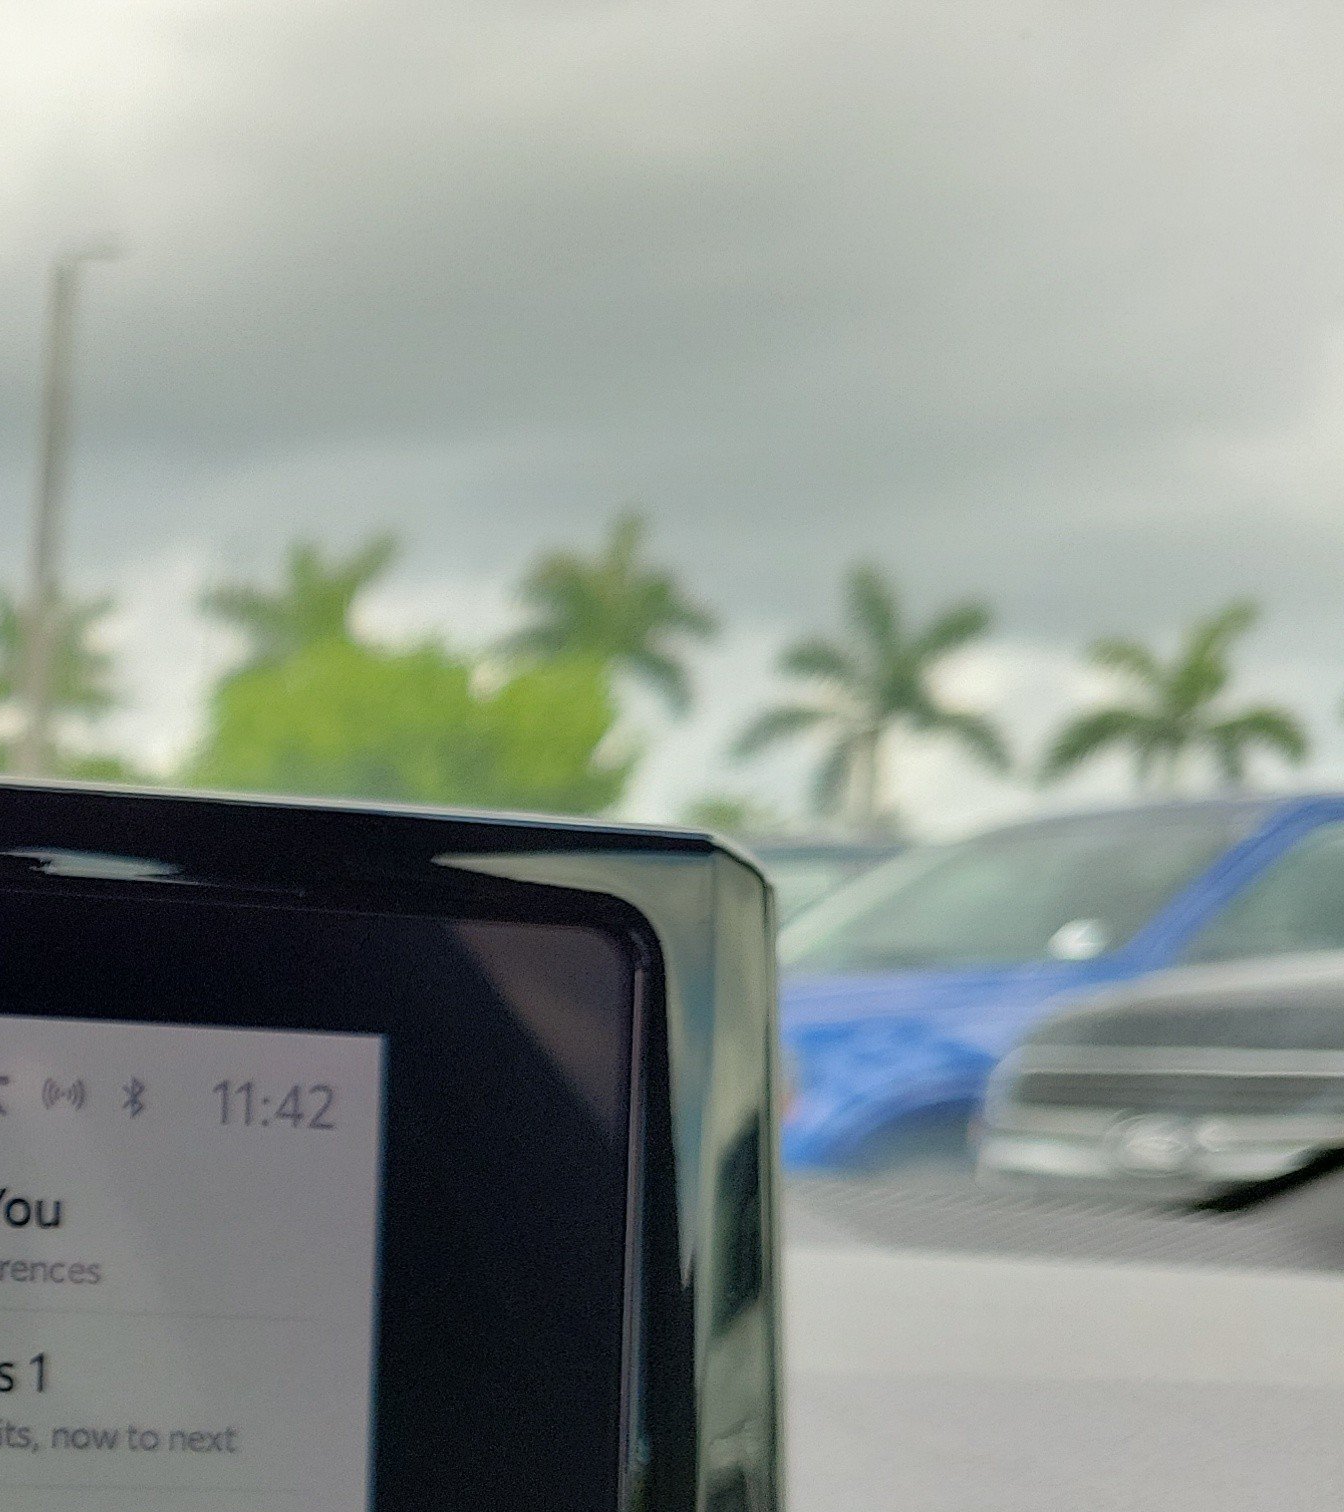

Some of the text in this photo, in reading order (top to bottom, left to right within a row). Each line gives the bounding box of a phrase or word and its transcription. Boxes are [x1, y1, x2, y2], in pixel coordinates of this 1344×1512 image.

[212, 1079, 336, 1131] 11:42
[29, 1352, 48, 1394] 1
[51, 1426, 120, 1451] now
[125, 1425, 162, 1453] to
[168, 1426, 238, 1454] next
